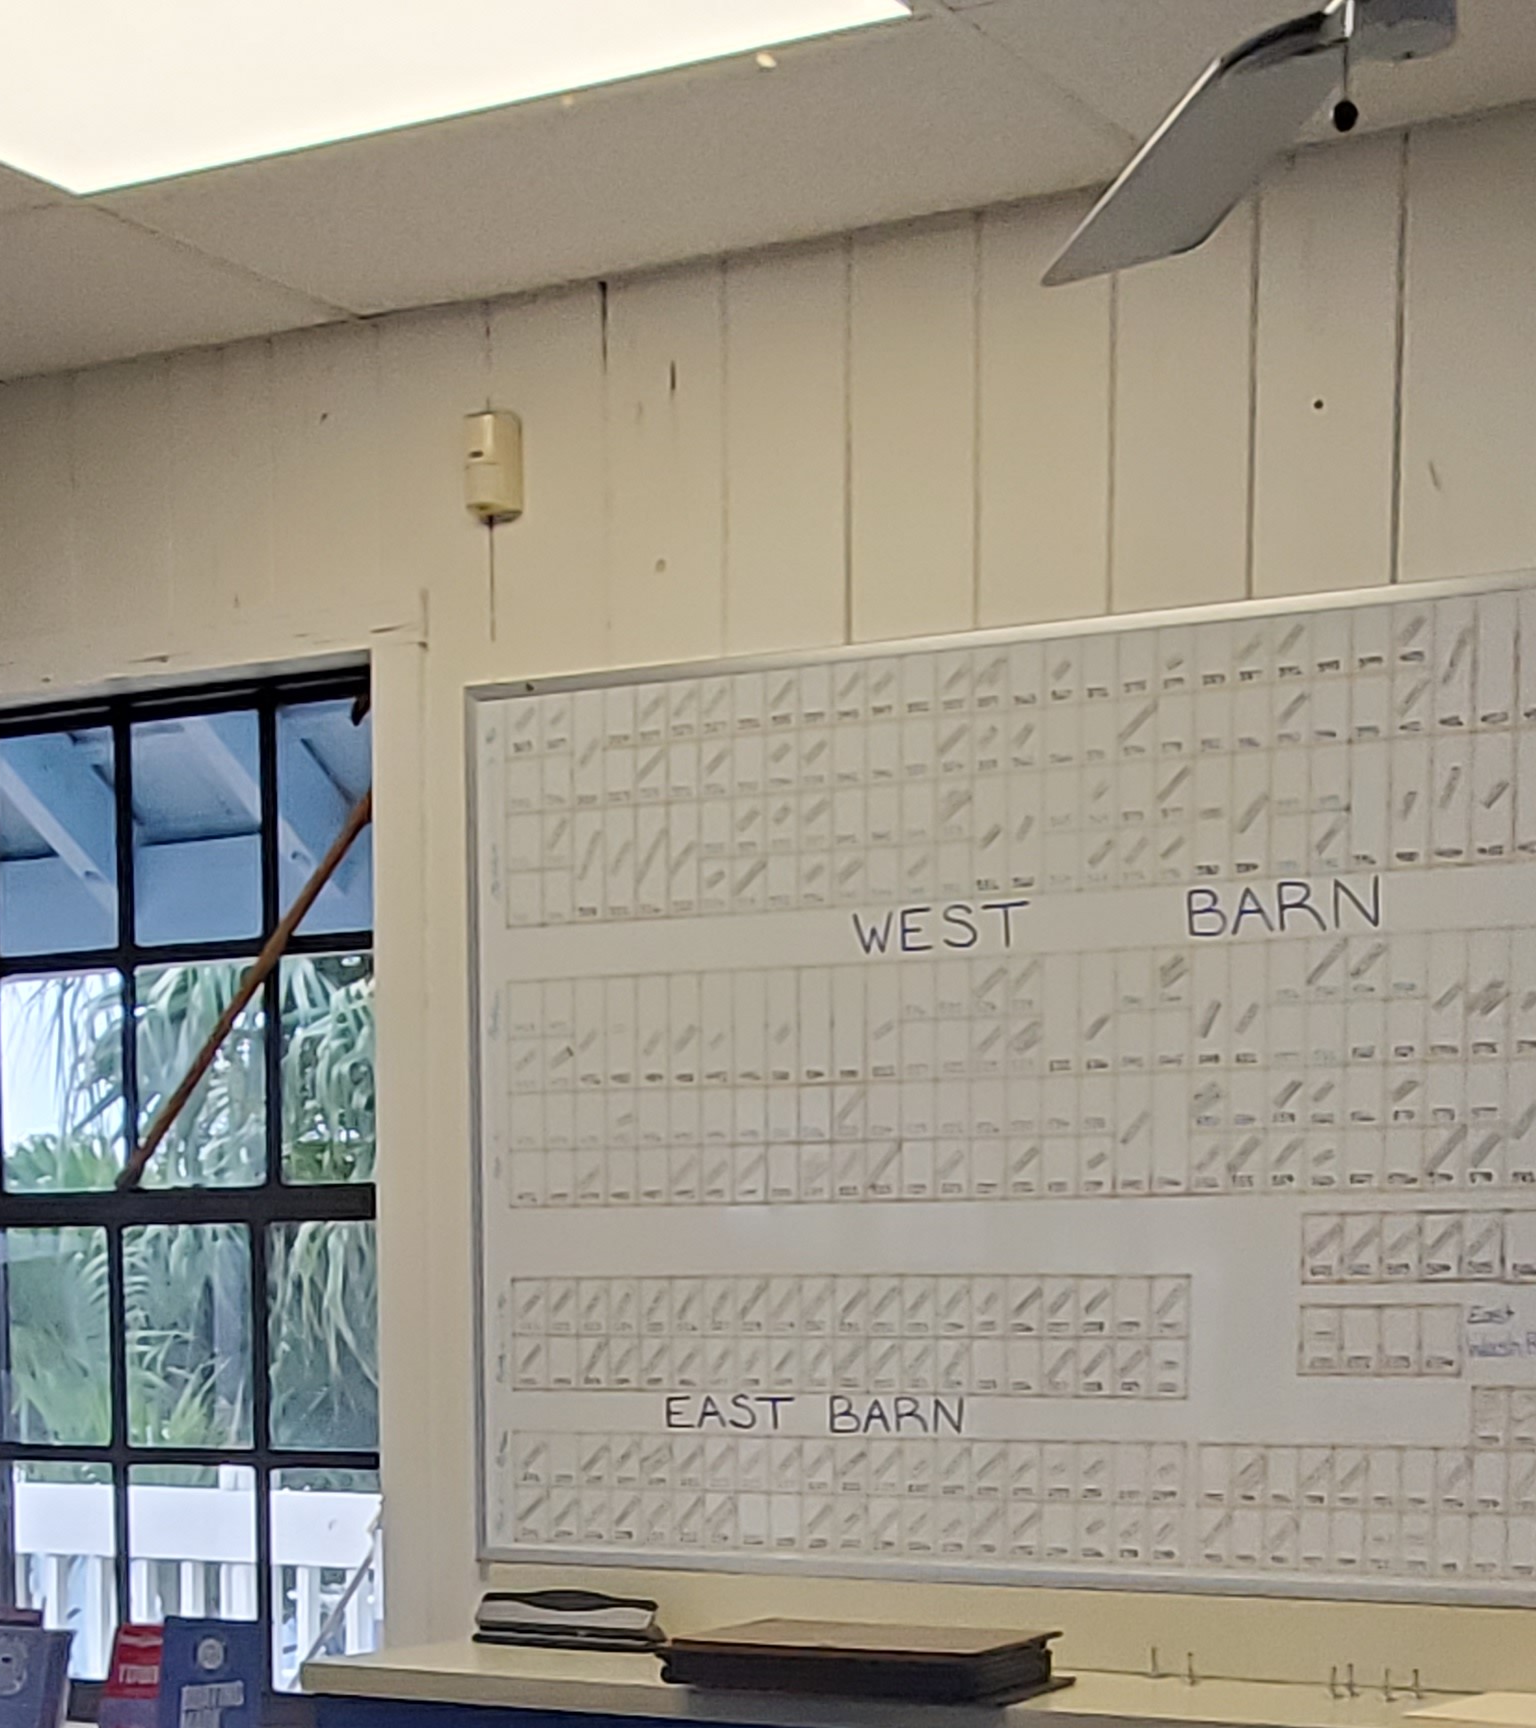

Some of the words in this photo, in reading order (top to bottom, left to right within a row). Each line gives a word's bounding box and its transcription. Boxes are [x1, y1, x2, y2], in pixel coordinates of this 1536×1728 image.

[852, 899, 1030, 955] WEST
[1186, 874, 1383, 937] BARN
[665, 1393, 796, 1431] EAST
[827, 1395, 965, 1435] BARN
